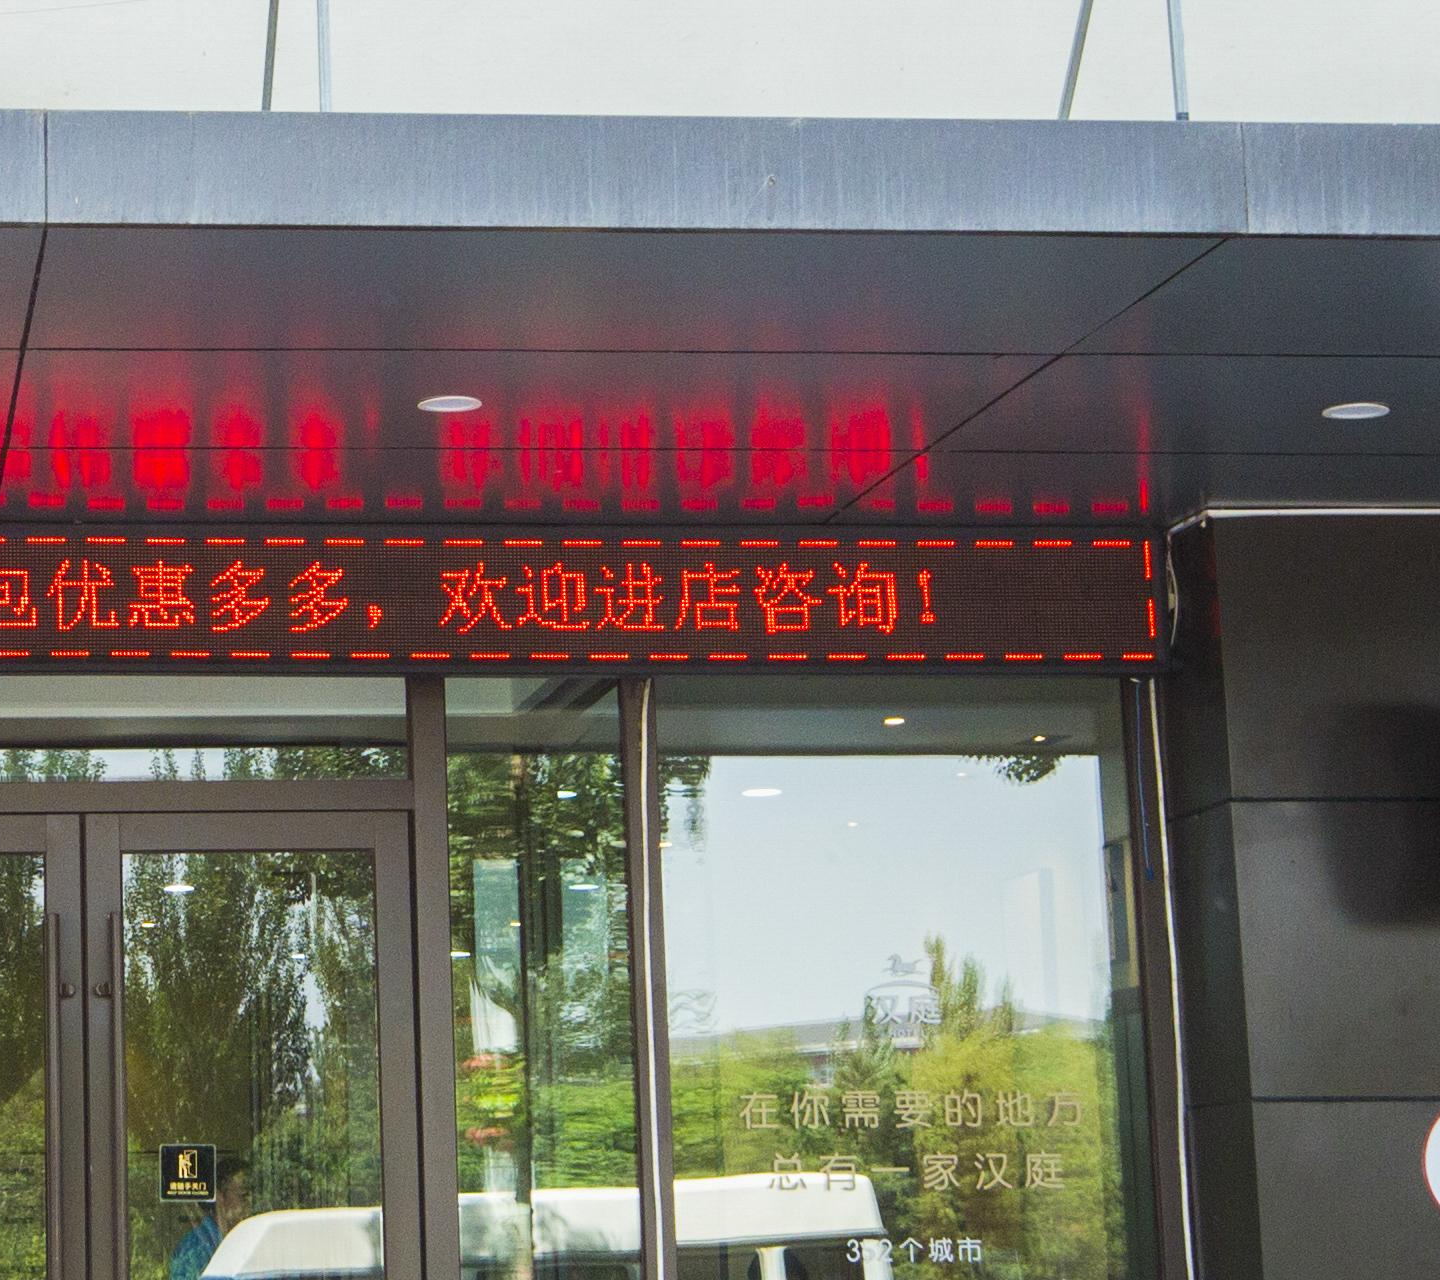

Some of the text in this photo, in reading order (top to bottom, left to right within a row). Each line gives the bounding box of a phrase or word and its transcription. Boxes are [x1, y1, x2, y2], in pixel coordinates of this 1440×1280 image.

[866, 993, 943, 1026] 汉庭
[738, 1088, 1083, 1130] 在你需要的地方
[767, 1152, 1065, 1192] 总有一家汉庭
